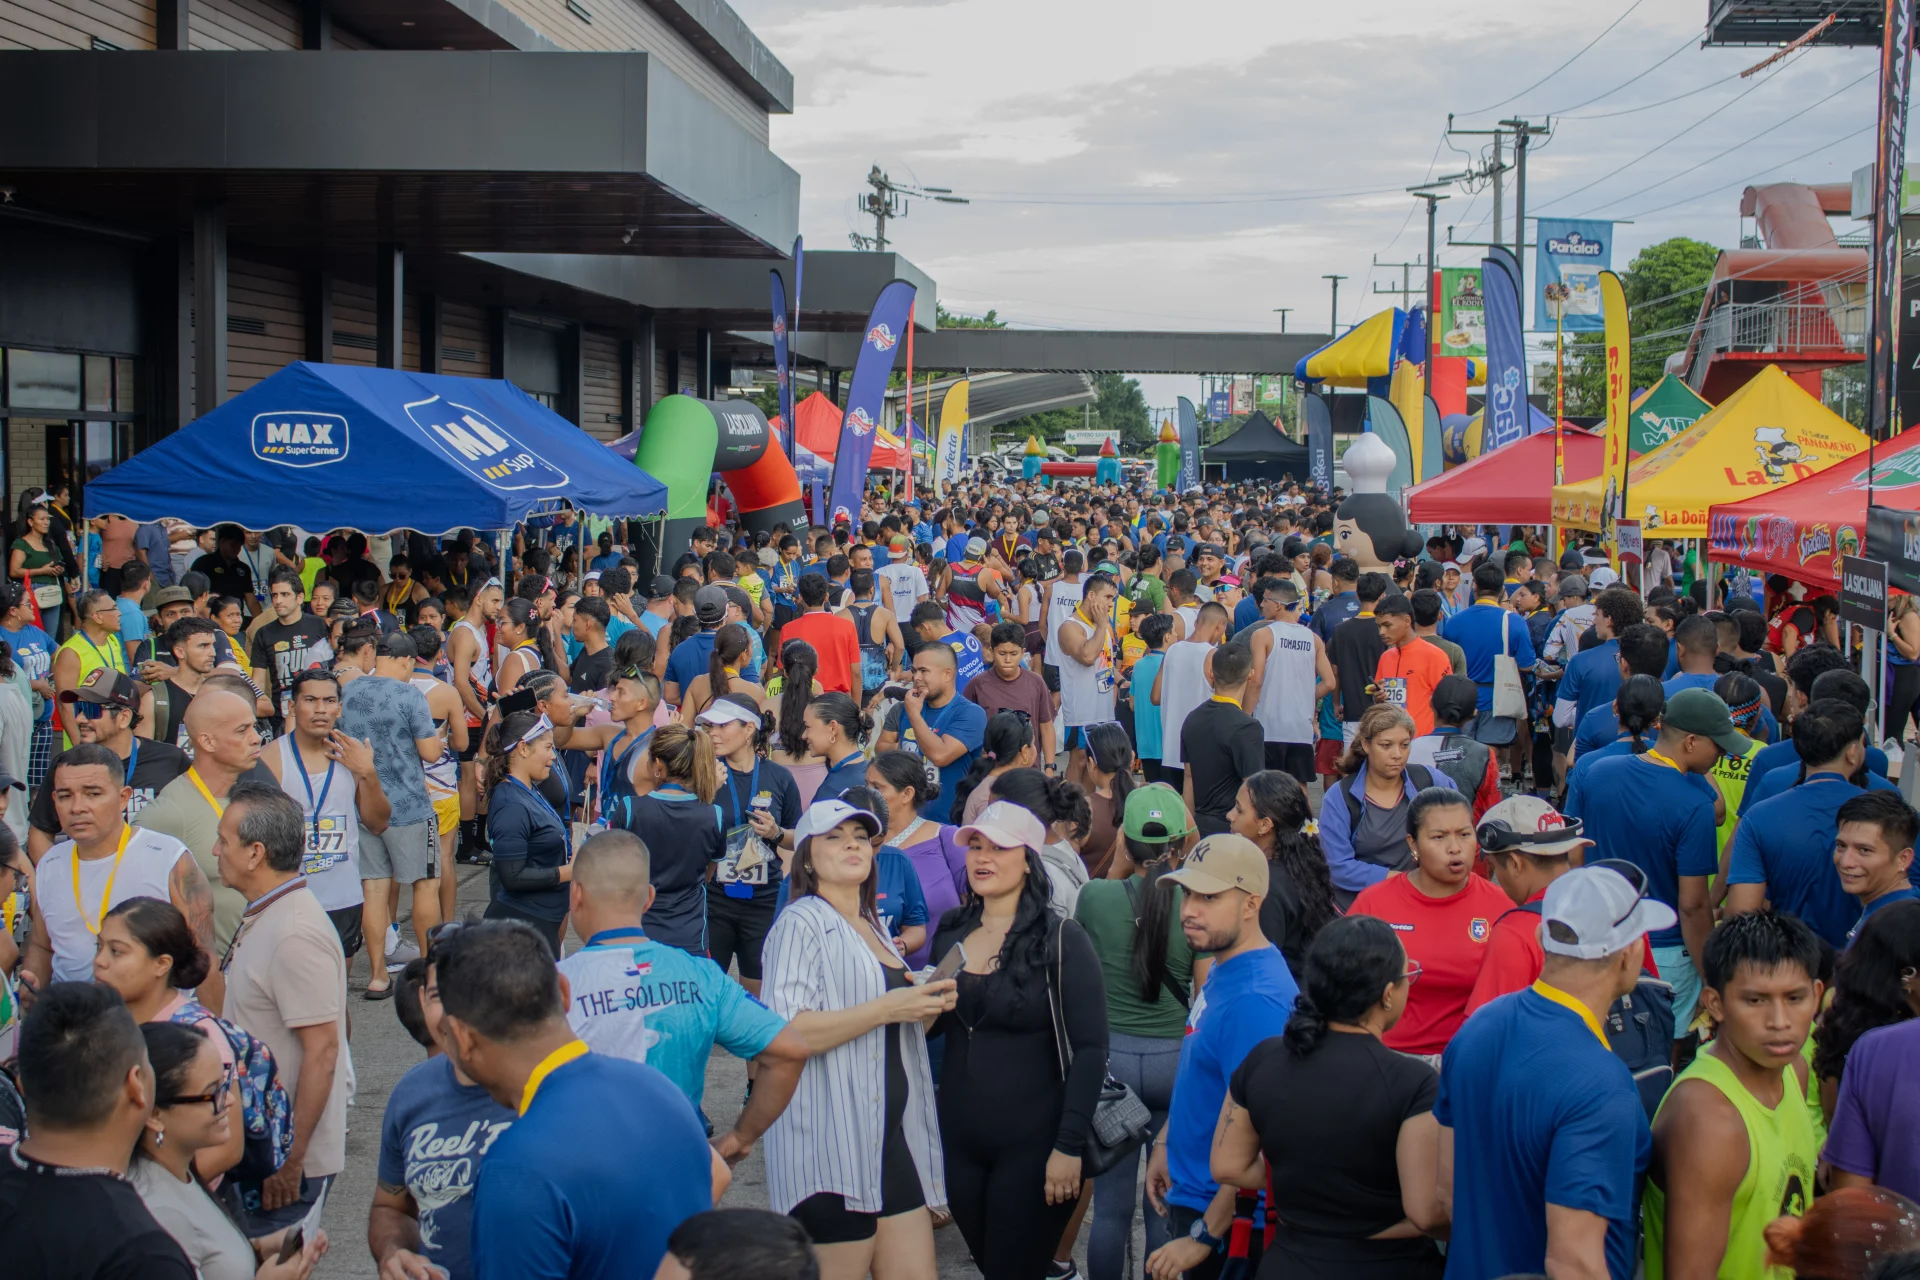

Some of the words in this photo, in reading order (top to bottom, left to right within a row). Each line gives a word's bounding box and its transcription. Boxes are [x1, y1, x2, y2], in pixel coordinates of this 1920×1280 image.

[1549, 240, 1600, 255] Panalat
[266, 423, 333, 445] MAX
[431, 414, 510, 462] MA
[1796, 435, 1857, 453] PANAMEÑO
[944, 433, 958, 480] erfecta
[1724, 467, 1768, 487] La
[1663, 510, 1678, 525] La
[1682, 509, 1710, 525] Doñ
[1044, 568, 1058, 580] bwin
[1056, 596, 1080, 607] TÁCTIC
[1279, 637, 1312, 652] TOMASITO
[958, 656, 980, 676] Somos
[1384, 688, 1403, 702] 216
[1719, 770, 1739, 780] PEÑA
[576, 989, 619, 1018] THE
[624, 980, 704, 1011] SOLDIER
